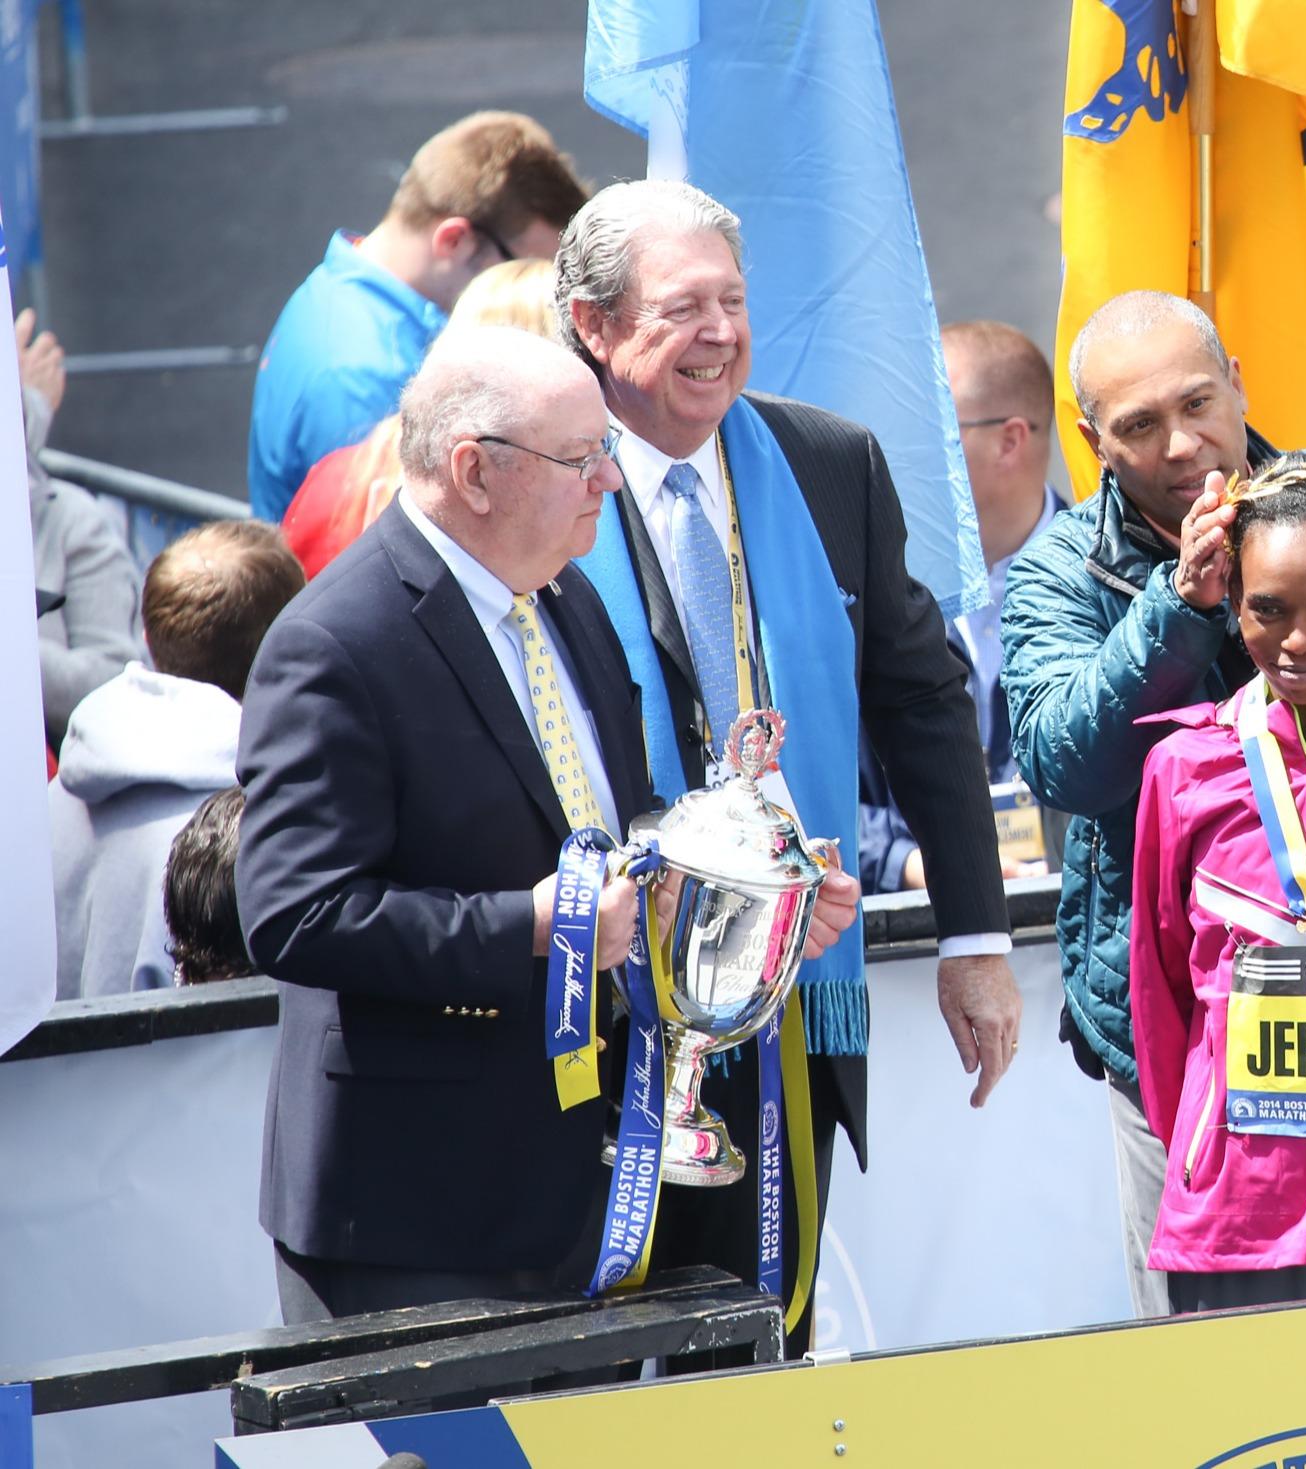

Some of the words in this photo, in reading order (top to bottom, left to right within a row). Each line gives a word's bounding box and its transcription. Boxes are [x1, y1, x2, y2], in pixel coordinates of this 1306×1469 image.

[1258, 1099, 1281, 1109] 2014
[614, 1146, 638, 1214] BOSTON
[771, 1144, 780, 1179] THE
[609, 1218, 627, 1249] THE
[624, 1148, 656, 1256] MARATHON
[761, 1150, 772, 1262] MARATHON
[771, 1185, 780, 1259] BOSTON
